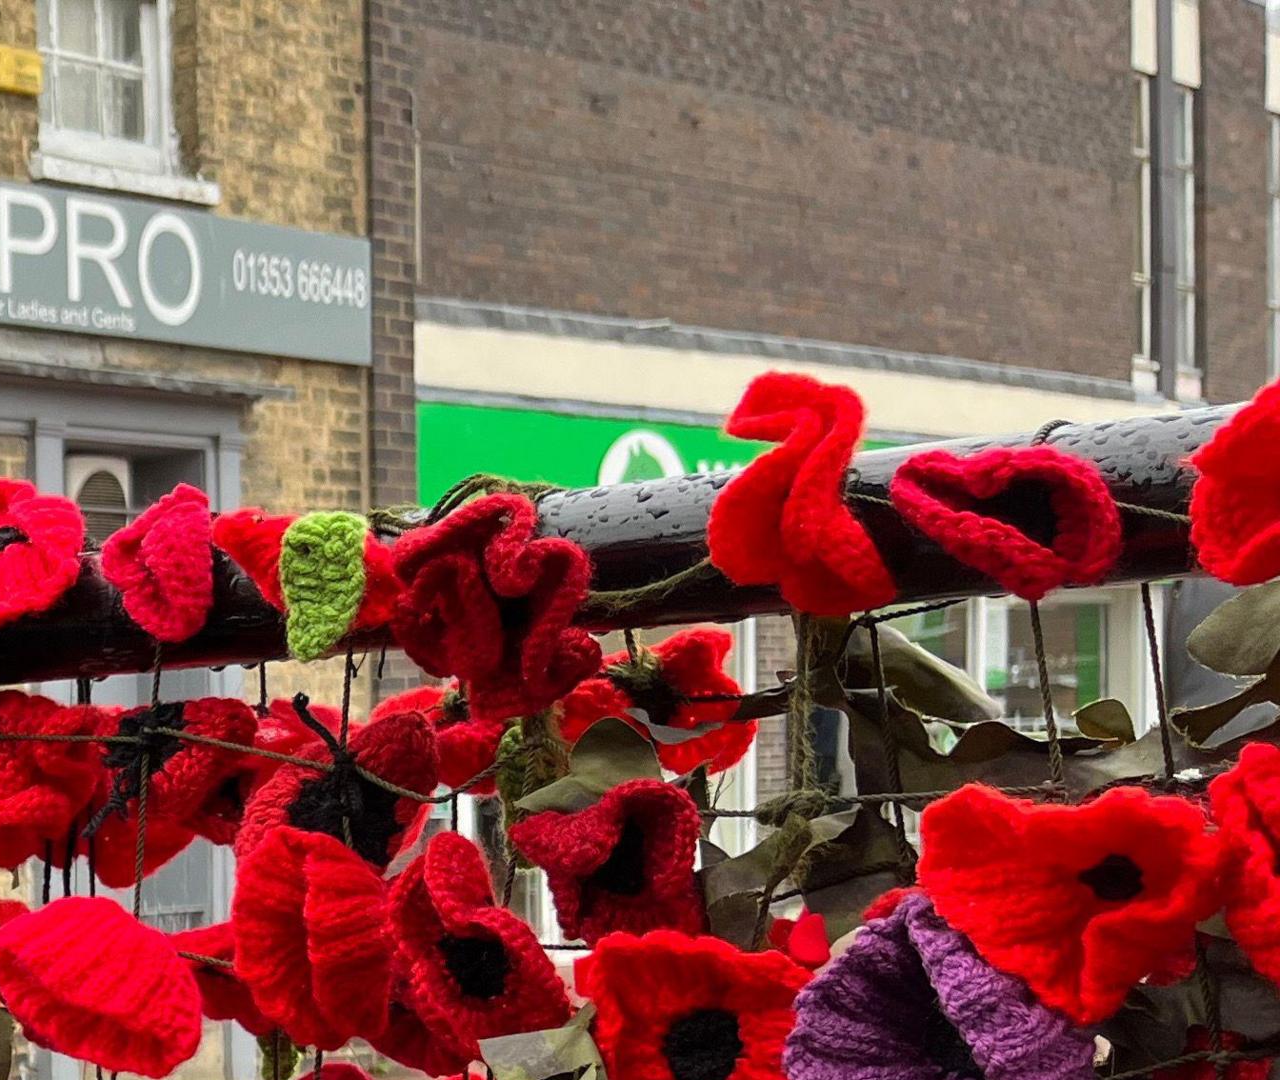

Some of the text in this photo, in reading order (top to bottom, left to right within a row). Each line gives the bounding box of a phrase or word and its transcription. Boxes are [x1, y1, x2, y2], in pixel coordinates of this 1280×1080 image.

[233, 249, 369, 309] 01353 666448
[8, 299, 59, 323] Ladies
[61, 305, 88, 326] and
[92, 307, 137, 333] Gents
